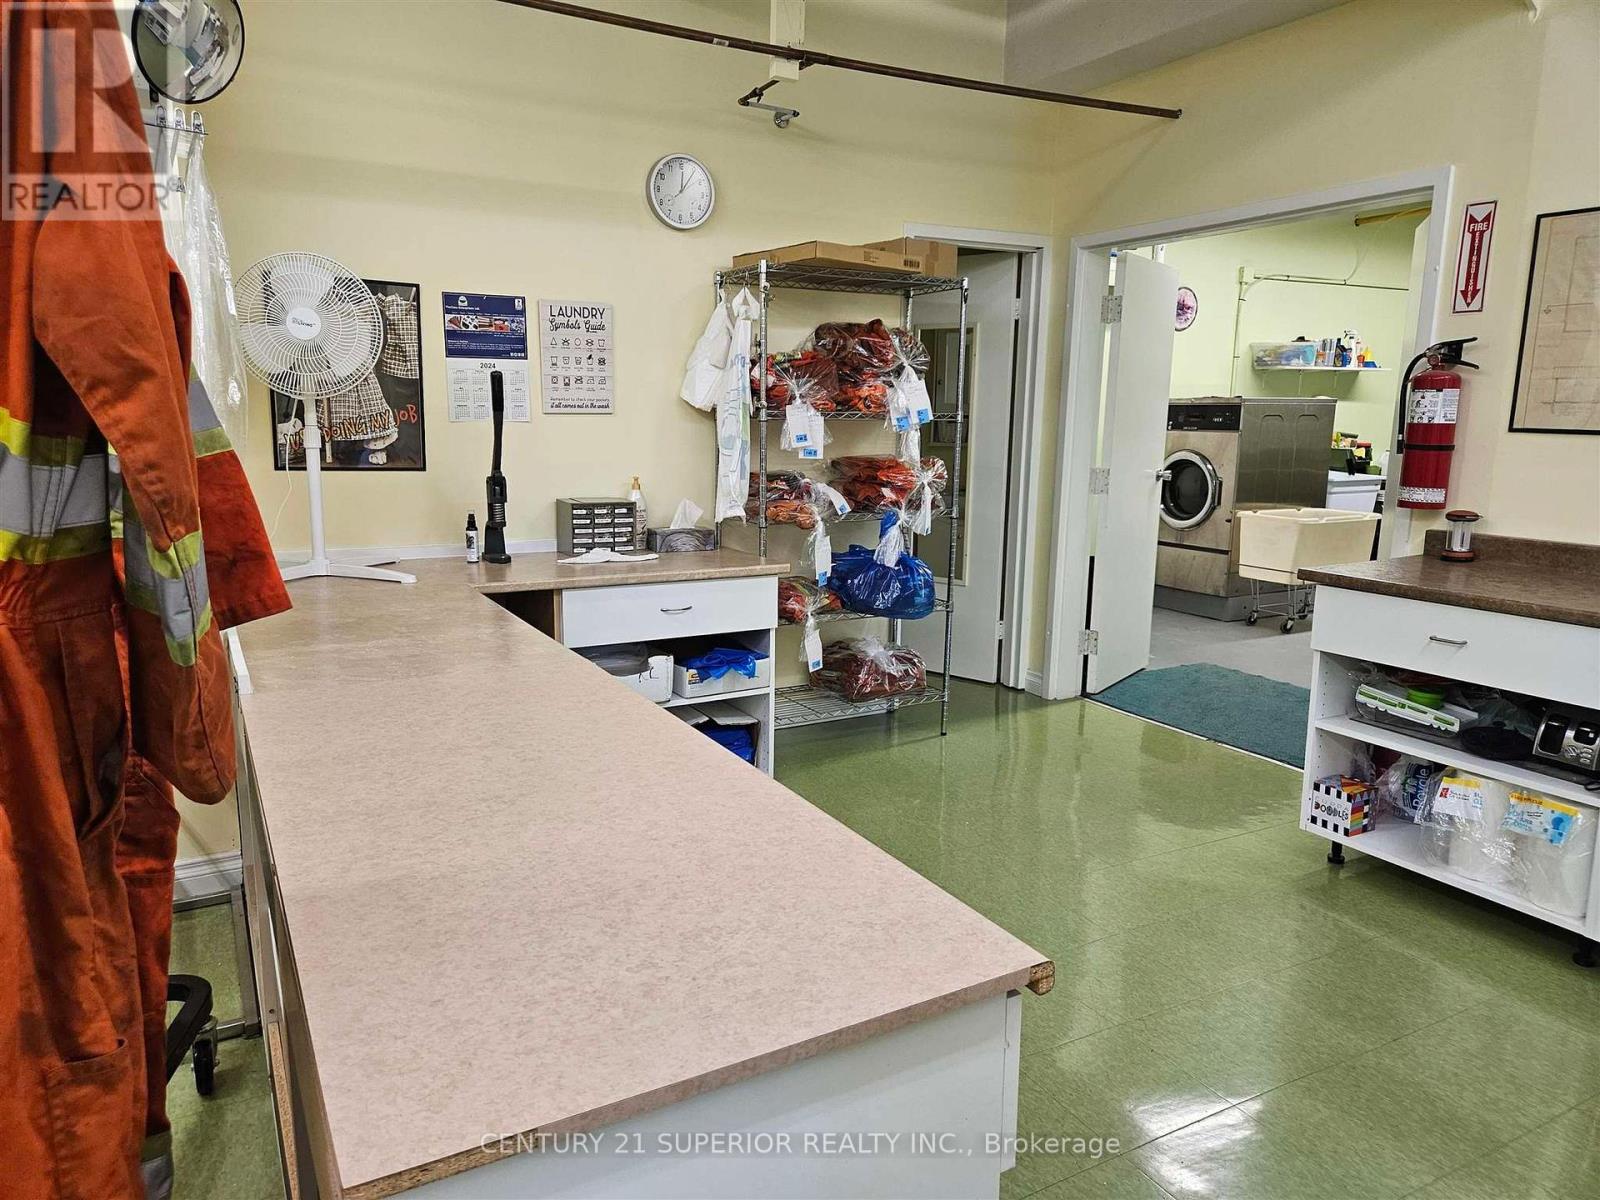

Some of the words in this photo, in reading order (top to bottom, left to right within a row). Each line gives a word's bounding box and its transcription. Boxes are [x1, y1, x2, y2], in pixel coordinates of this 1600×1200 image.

[1469, 221, 1489, 232] FIRE
[549, 304, 606, 319] LAUNDRY
[548, 317, 581, 332] Symbols
[583, 319, 607, 333] Guide
[322, 415, 368, 442] DOING
[369, 409, 391, 432] MY
[394, 404, 418, 427] JOB
